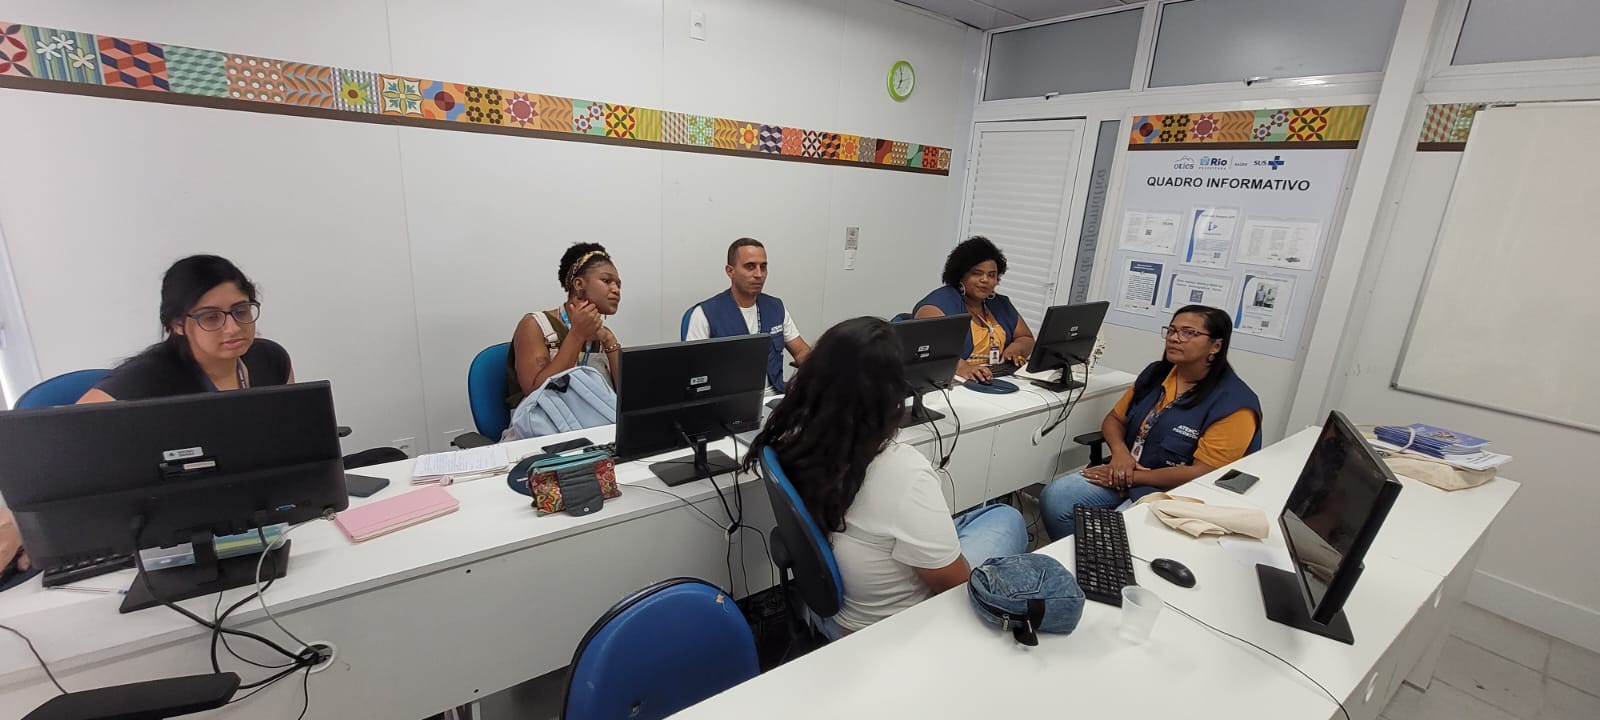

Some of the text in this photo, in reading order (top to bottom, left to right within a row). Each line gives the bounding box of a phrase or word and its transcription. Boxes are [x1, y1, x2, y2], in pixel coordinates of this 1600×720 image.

[1173, 162, 1194, 170] otics
[1210, 157, 1228, 167] Rio
[1146, 176, 1311, 191] QUADRO INFORMATIVO
